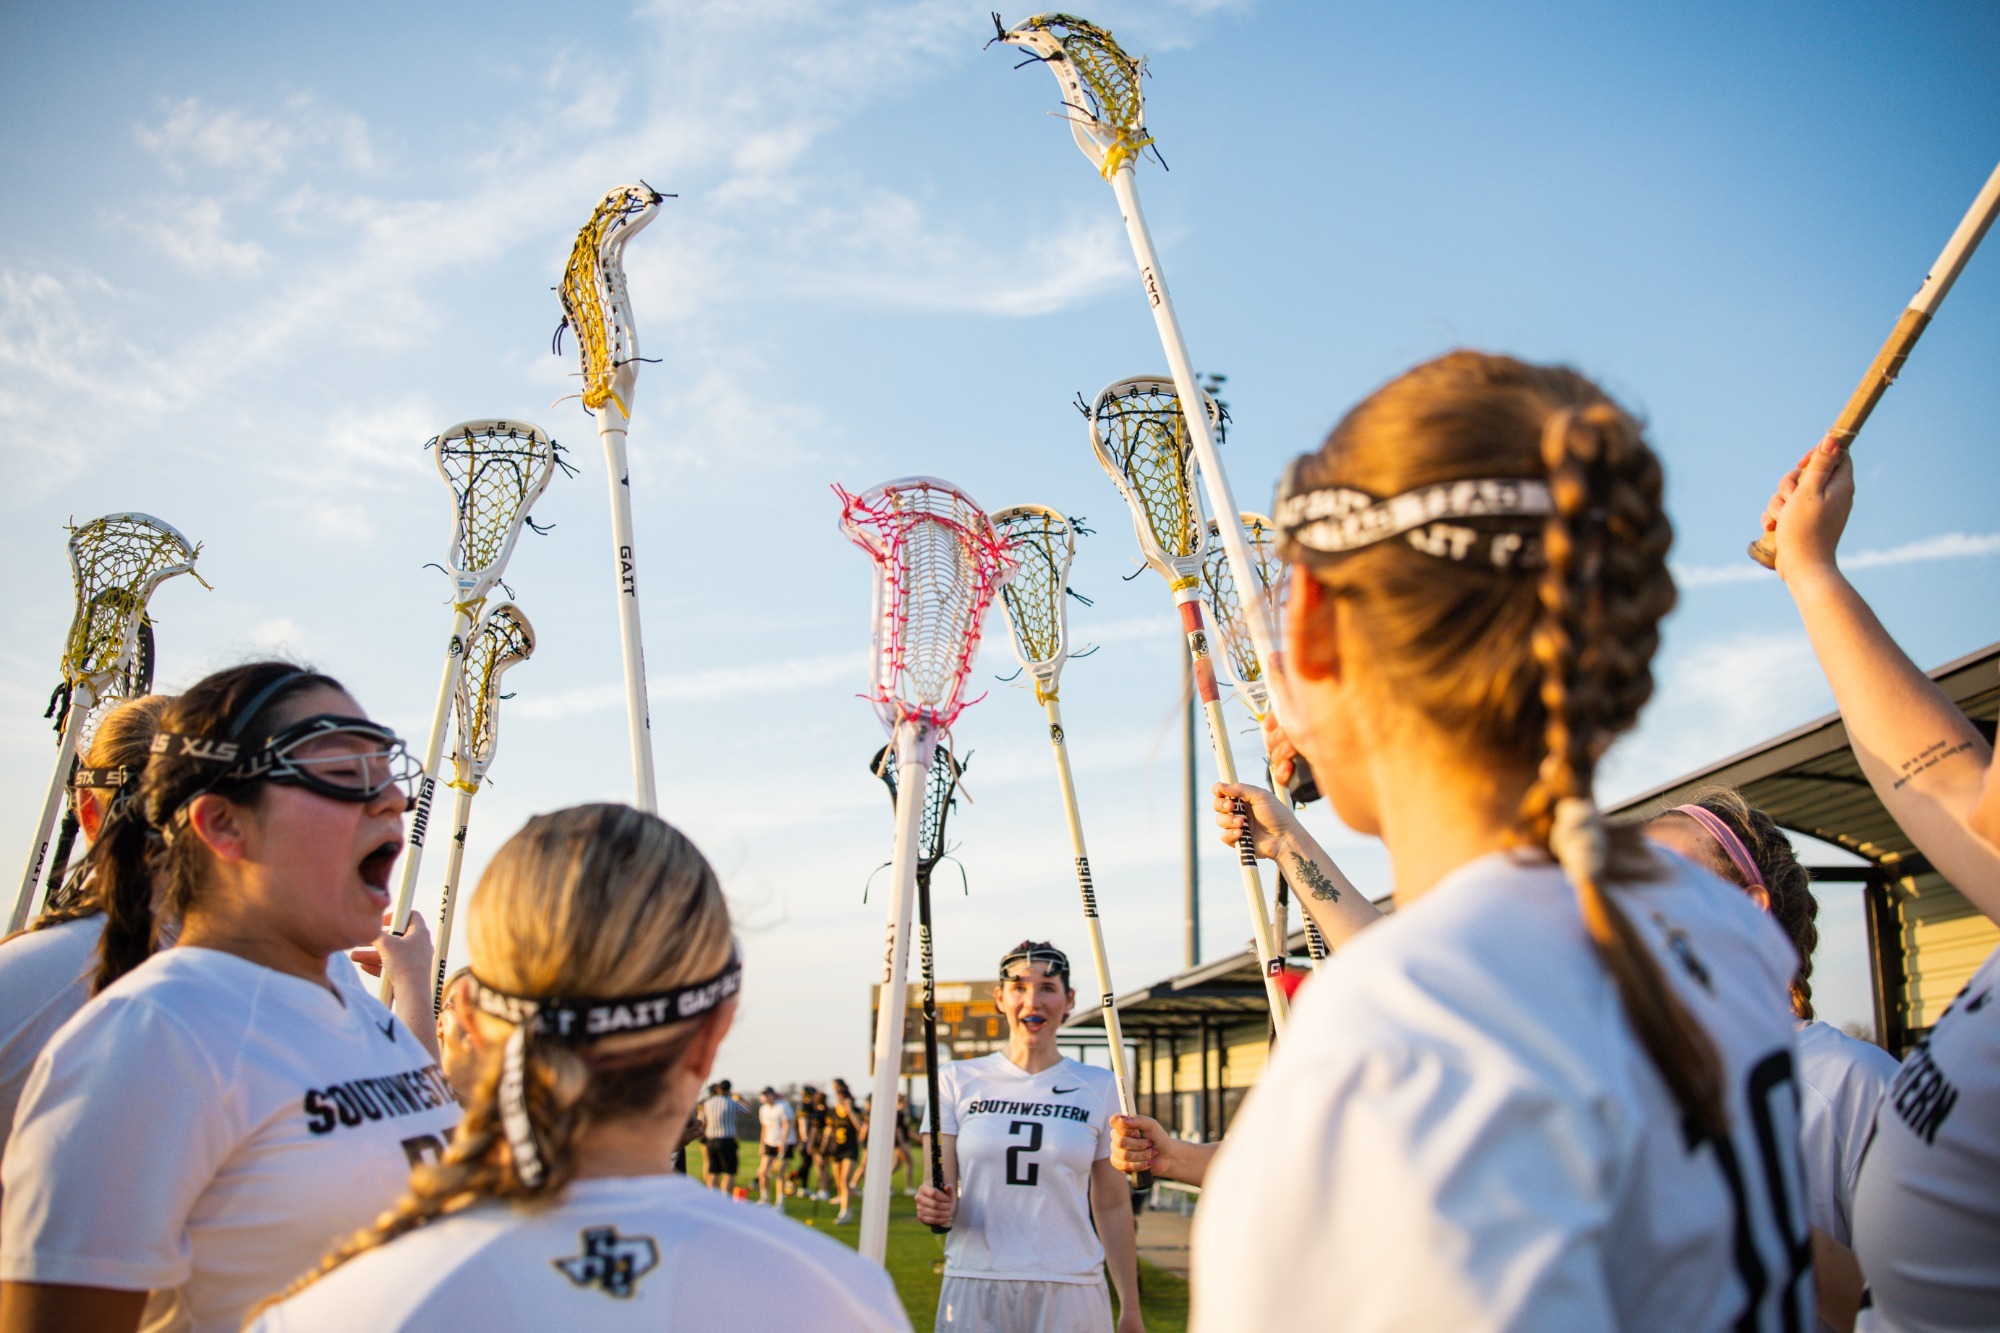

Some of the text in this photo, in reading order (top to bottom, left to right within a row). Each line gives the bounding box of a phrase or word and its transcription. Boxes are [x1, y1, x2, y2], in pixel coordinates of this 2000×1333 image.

[620, 545, 635, 597] GAIT
[75, 770, 95, 786] STX
[408, 777, 435, 849] PIRATES
[1075, 857, 1099, 918] PIRATES
[919, 924, 934, 1002] PIRATES
[967, 1099, 1091, 1123] SOUTHWESTERN
[1006, 1120, 1043, 1187] 2
